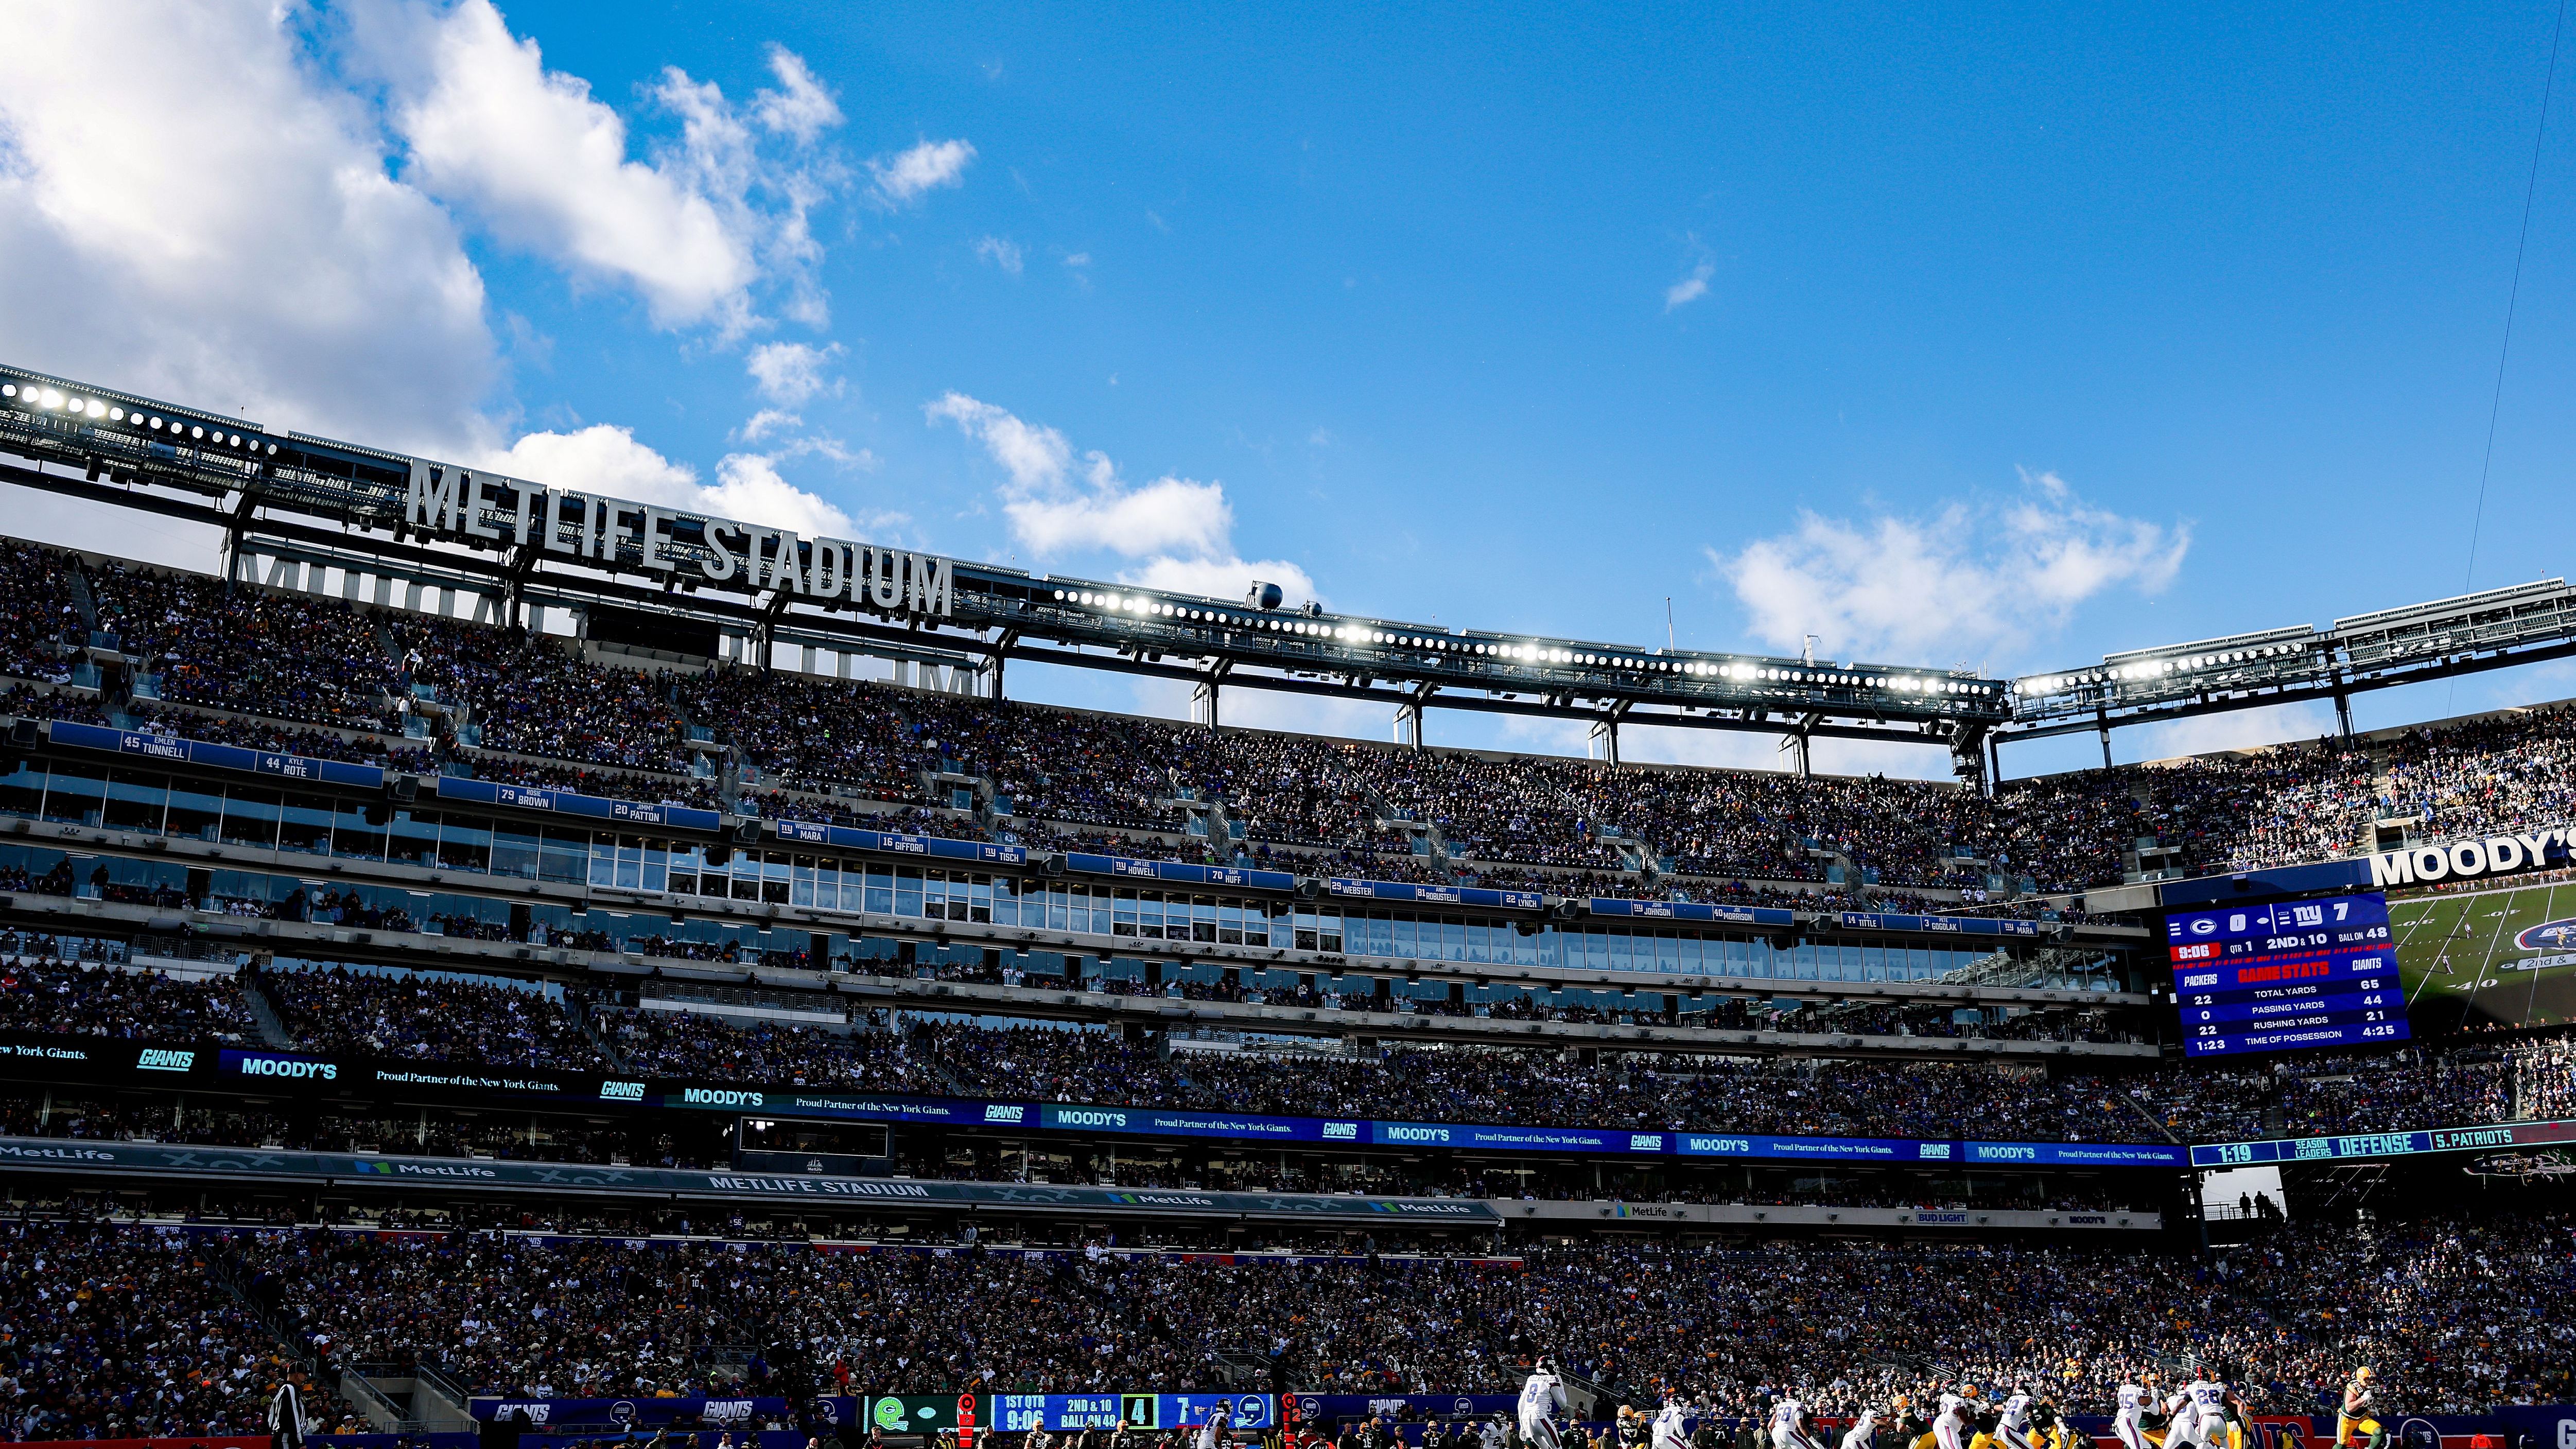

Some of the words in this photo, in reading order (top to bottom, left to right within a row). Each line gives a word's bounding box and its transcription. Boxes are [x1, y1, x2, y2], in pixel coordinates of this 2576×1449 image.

[406, 457, 677, 572] METLIFE
[701, 517, 952, 617] STADIUM
[125, 737, 140, 747] 45
[154, 737, 175, 745] EMLEN
[143, 743, 184, 758] TUNNELL
[267, 758, 280, 768] 44
[284, 765, 307, 777] ROTE
[502, 789, 514, 799] 79
[518, 795, 549, 808] BROWN
[616, 805, 627, 814] 20
[631, 810, 659, 822] PATTON
[795, 823, 825, 832] WELLINGTON
[800, 830, 821, 841] MARA
[883, 837, 893, 846] 16
[895, 842, 923, 852] GIFFORD
[999, 852, 1018, 862] TISCH
[1128, 866, 1155, 876] HOWELL
[1213, 871, 1222, 879] 70
[1226, 875, 1241, 883] HUFF
[1332, 882, 1341, 890] 29
[1343, 886, 1371, 895] WEBSTER
[1426, 892, 1457, 901] ROBUSTELLI
[1519, 899, 1537, 907] LYNCH
[1644, 907, 1670, 916] JOHNSON
[1724, 913, 1752, 921] MORRISON
[2230, 914, 2246, 931] 0
[2334, 903, 2348, 920] 7
[2179, 945, 2209, 958] 9:06
[2230, 945, 2242, 954] QTR
[2246, 941, 2252, 951] 1
[2267, 937, 2298, 949] 2ND
[2308, 934, 2327, 945] 10
[2339, 933, 2354, 941] BALL
[2367, 927, 2387, 938] 48
[2185, 974, 2217, 987] PACKERS
[2238, 966, 2281, 983] GAME
[2282, 962, 2329, 979] STATS
[2353, 958, 2381, 970] GIANTS
[2195, 996, 2212, 1005] 22
[2255, 989, 2284, 998] TOTAL
[2286, 986, 2316, 994] YARDS
[2361, 980, 2379, 989] 65
[2201, 1011, 2209, 1019] 0
[2252, 1004, 2291, 1014] PASSING
[2293, 1001, 2324, 1010] YARDS
[2364, 996, 2382, 1005] 44
[2199, 1026, 2217, 1035] 22
[2254, 1020, 2295, 1029] RUSHING
[2297, 1017, 2328, 1025] YARDS
[2366, 1011, 2383, 1020] 21
[2197, 1040, 2225, 1050] 1:23
[2284, 1031, 2342, 1042] POSSESSION
[2363, 1025, 2394, 1036] 4:25
[16, 1045, 43, 1056] York
[47, 1048, 87, 1059] Giants.
[137, 1049, 194, 1071] GIANTS
[242, 1058, 337, 1079] MOODY'S
[377, 1071, 408, 1081] Proud
[410, 1073, 448, 1084] Partner
[450, 1076, 461, 1084] of
[462, 1077, 477, 1085] the
[480, 1078, 500, 1087] New
[503, 1079, 525, 1089] York
[528, 1081, 560, 1090] Giants.
[600, 1081, 645, 1101] GIANTS
[685, 1089, 762, 1106] MOODY'S
[796, 1097, 822, 1108] Proud
[824, 1100, 856, 1109] Partner
[902, 1105, 921, 1113] York
[923, 1105, 951, 1115] Giants.
[984, 1105, 1023, 1122] GIANTS
[1058, 1111, 1125, 1126] MOODY'S
[1322, 1123, 1357, 1139] GIANTS
[1388, 1127, 1449, 1141] MOODY'S
[1630, 1135, 1661, 1150] GIANTS
[1691, 1139, 1748, 1151] MOODY'S
[2296, 1140, 2327, 1149] SEASON
[2339, 1134, 2414, 1155] DEFENSE
[0, 1147, 114, 1159] MetLife
[1920, 1144, 1950, 1158] GIANTS
[1978, 1147, 2034, 1158] MOODY'S
[2218, 1145, 2251, 1162] 1:19
[2295, 1148, 2331, 1158] LEADERS
[399, 1165, 495, 1176] MetLife
[709, 1177, 817, 1192] METLIFE
[819, 1182, 929, 1197] STADIUM
[1139, 1196, 1213, 1204] MetLife
[1632, 1207, 1667, 1216] MetLife
[1918, 1214, 1938, 1223] BUD
[1939, 1214, 1966, 1223] LIGHT
[1527, 1384, 1538, 1402] 8
[2119, 1393, 2133, 1409] 95
[702, 1401, 753, 1424] GIANTS
[1005, 1395, 1023, 1408] 1ST
[1025, 1395, 1045, 1409] QTR
[1068, 1400, 1087, 1411] 2ND
[1090, 1402, 1098, 1411] &
[1100, 1400, 1111, 1411] 10
[1132, 1399, 1145, 1424] 4
[1177, 1398, 1189, 1423] 7
[1061, 1415, 1085, 1427] BALL
[1103, 1415, 1116, 1427] 48
[1715, 1431, 1726, 1439] 71
